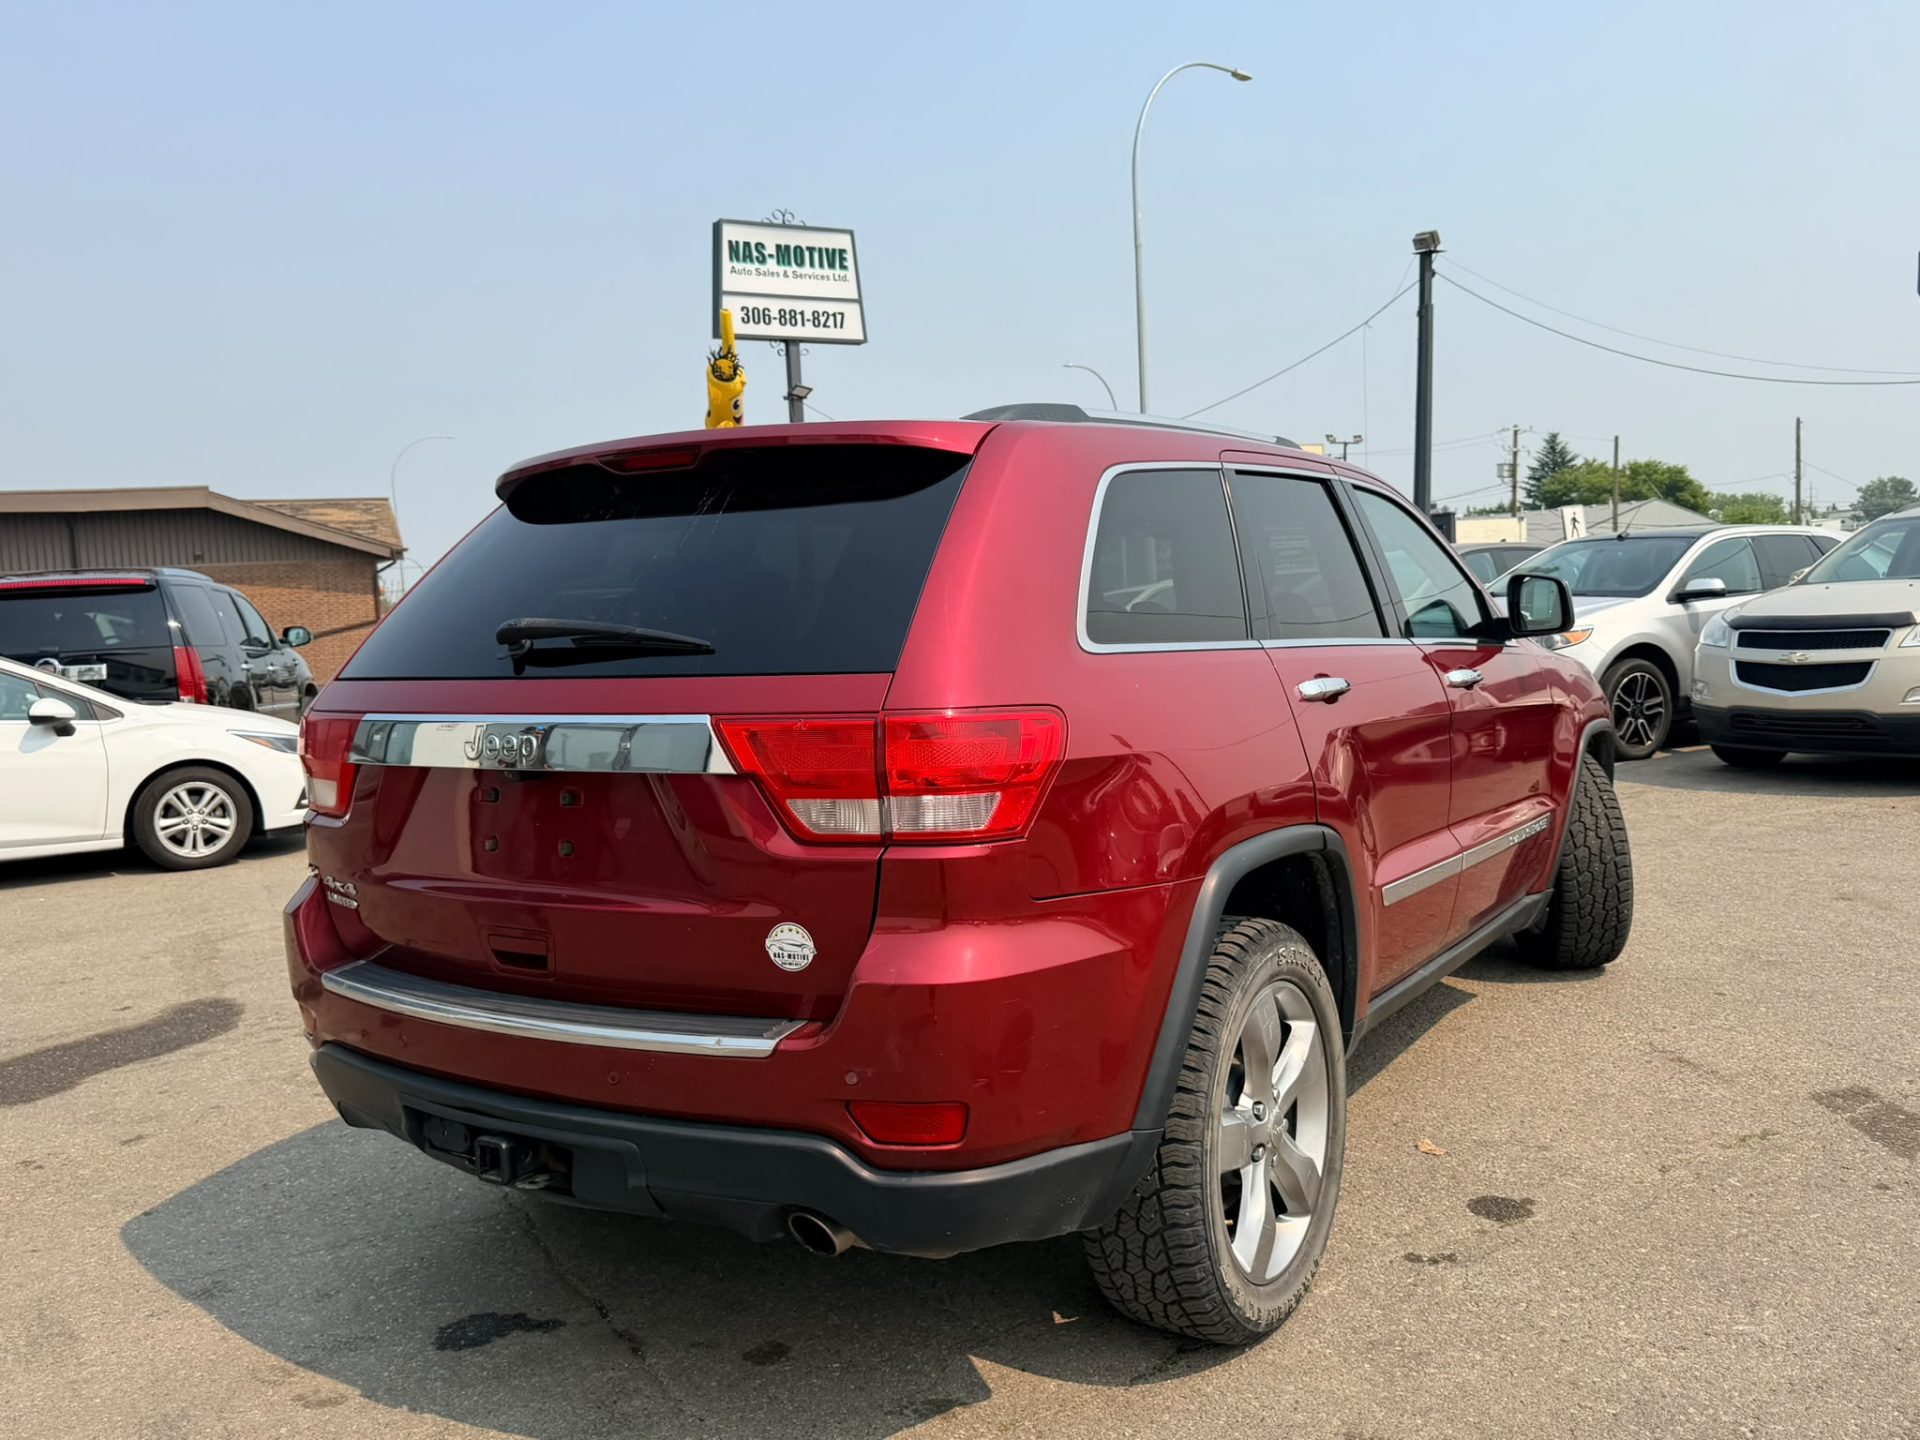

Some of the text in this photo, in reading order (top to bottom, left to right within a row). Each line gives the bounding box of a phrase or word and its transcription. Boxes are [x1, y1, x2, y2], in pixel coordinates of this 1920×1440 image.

[727, 239, 849, 271] NAS-MOTIVE
[730, 266, 850, 283] Auto Sales & Services Ltd.
[740, 306, 845, 329] 306-881-8217
[464, 724, 537, 767] Jeep
